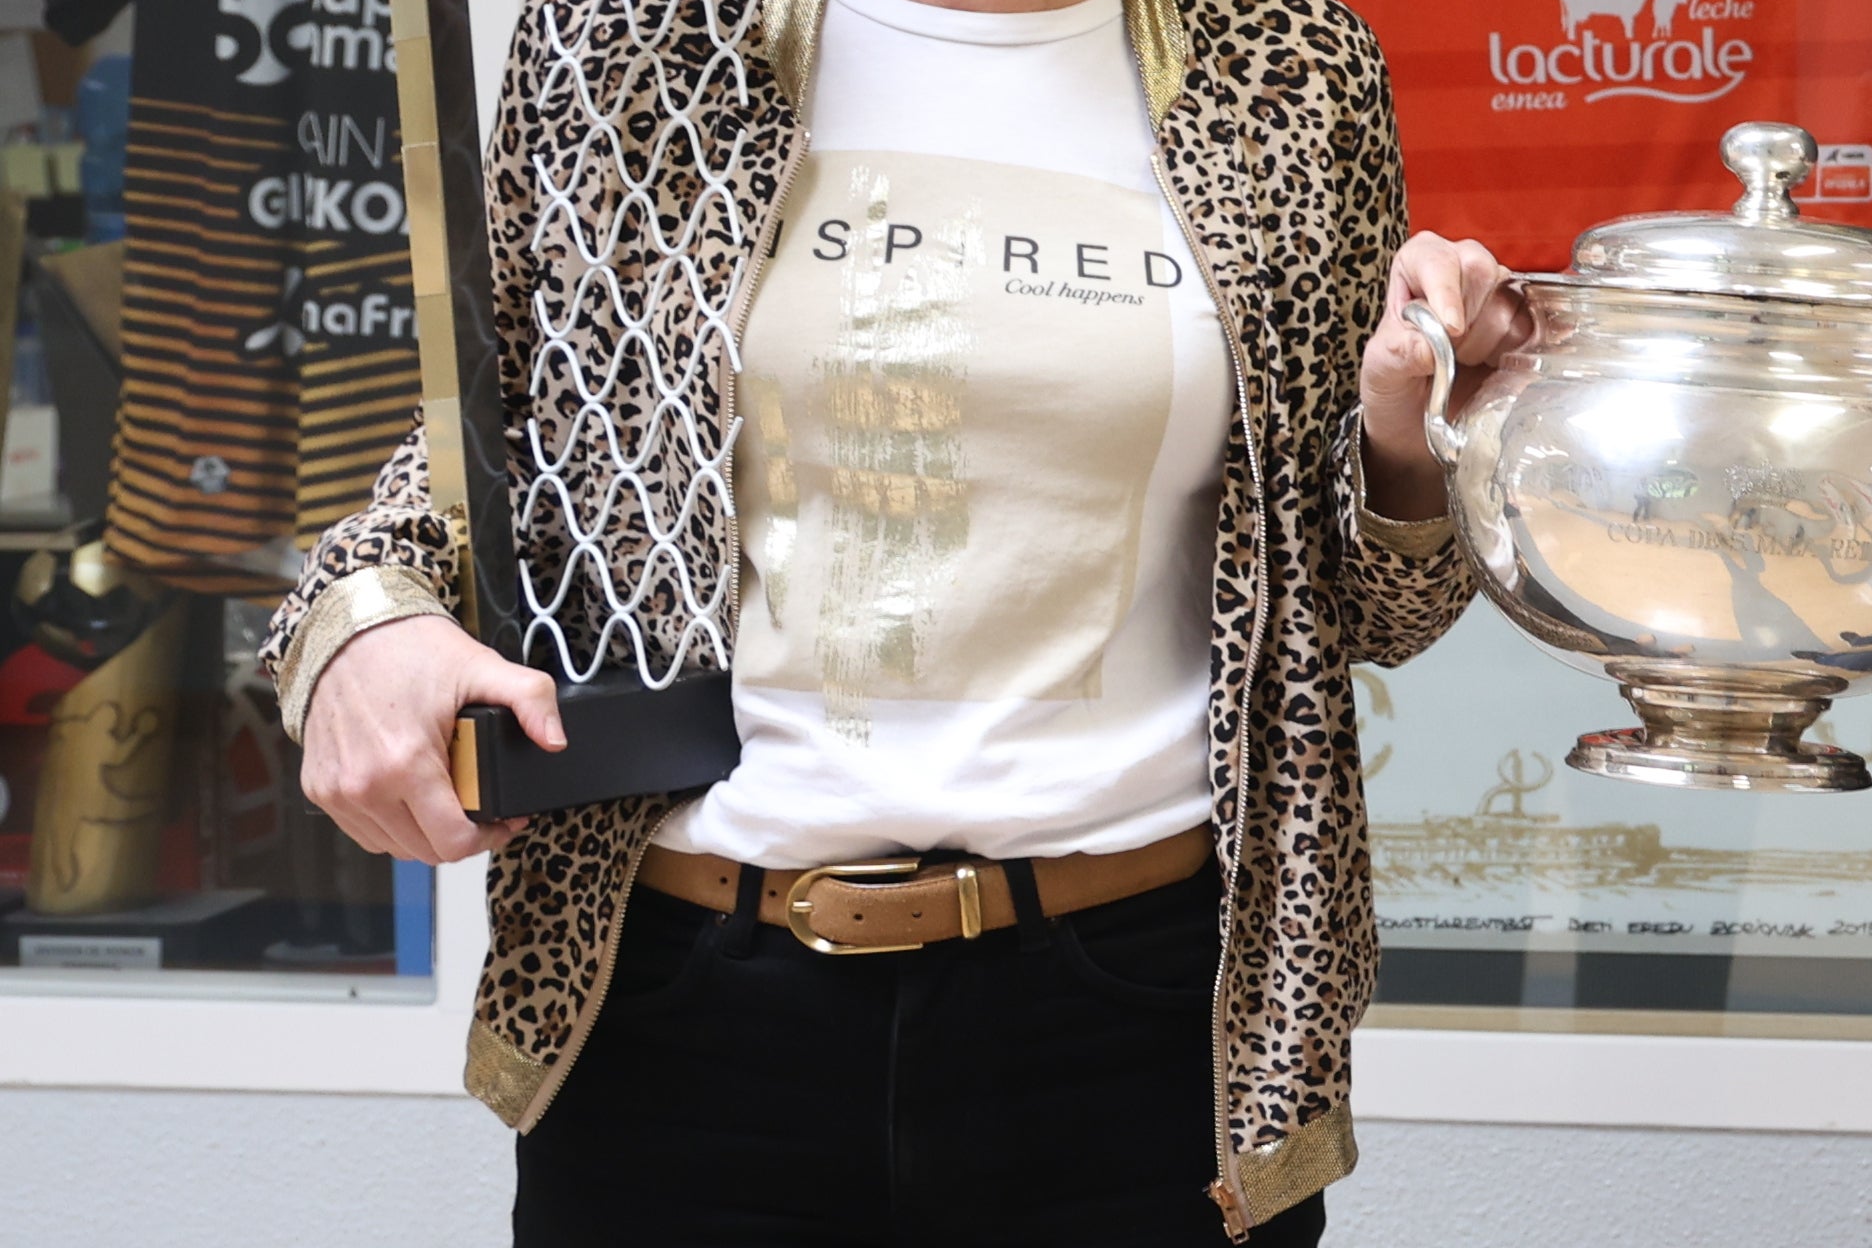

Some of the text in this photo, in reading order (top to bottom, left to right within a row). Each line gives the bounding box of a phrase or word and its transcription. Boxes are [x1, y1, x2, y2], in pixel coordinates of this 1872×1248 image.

[1488, 26, 1754, 86] lacturale
[1491, 90, 1567, 111] esnea
[1005, 278, 1144, 307] Cool happens
[1606, 520, 1678, 547] COPA
